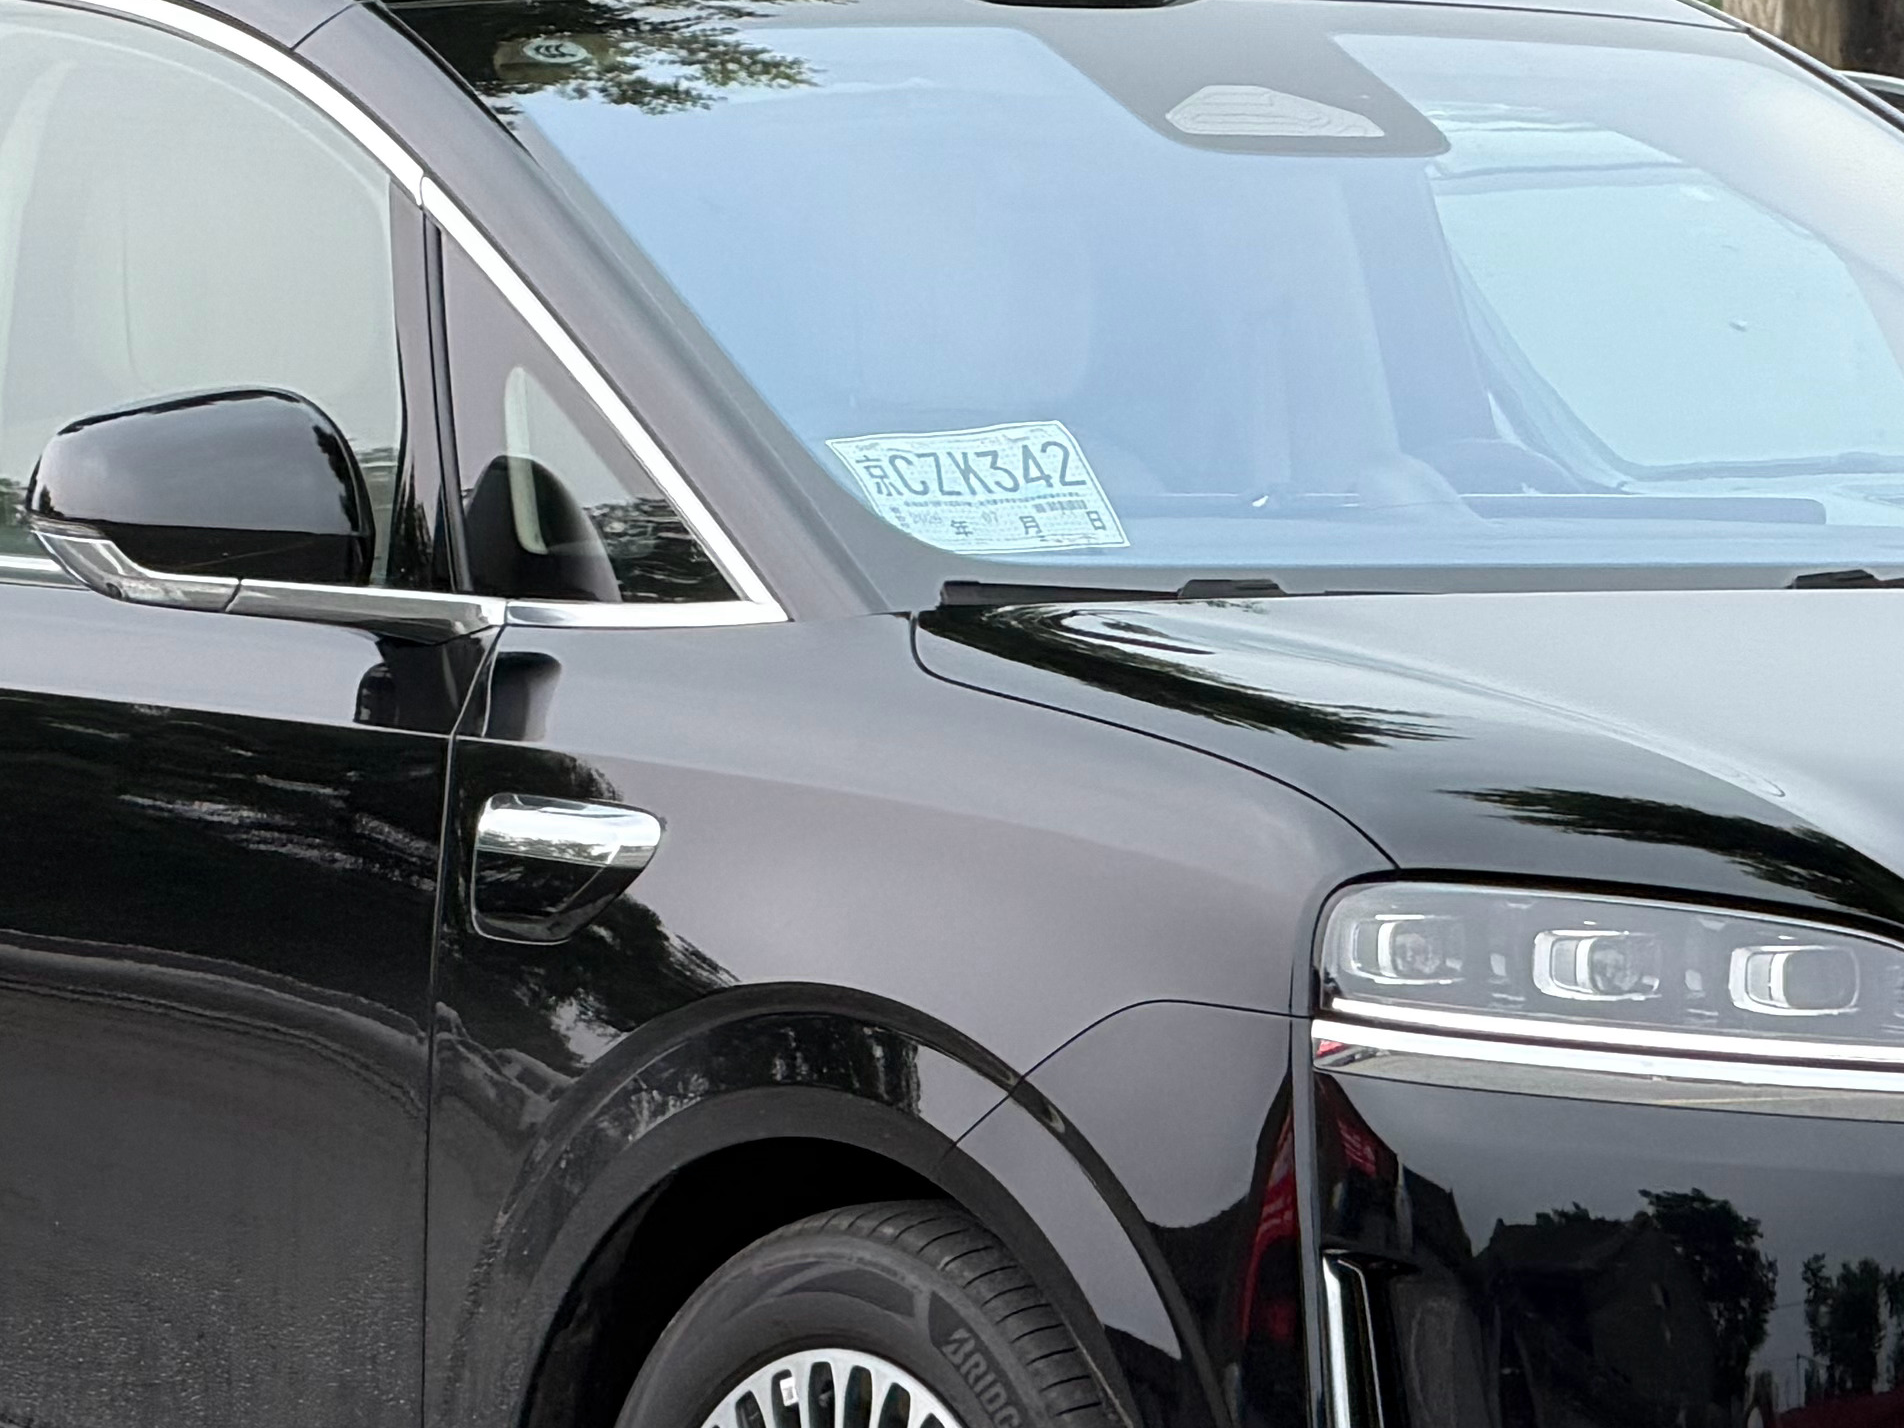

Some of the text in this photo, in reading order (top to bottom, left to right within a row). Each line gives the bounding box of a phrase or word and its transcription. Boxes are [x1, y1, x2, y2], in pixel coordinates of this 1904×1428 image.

[855, 441, 1087, 497] 京CZK342
[950, 519, 973, 537] 年
[1018, 515, 1043, 535] 月
[1085, 510, 1107, 530] 日
